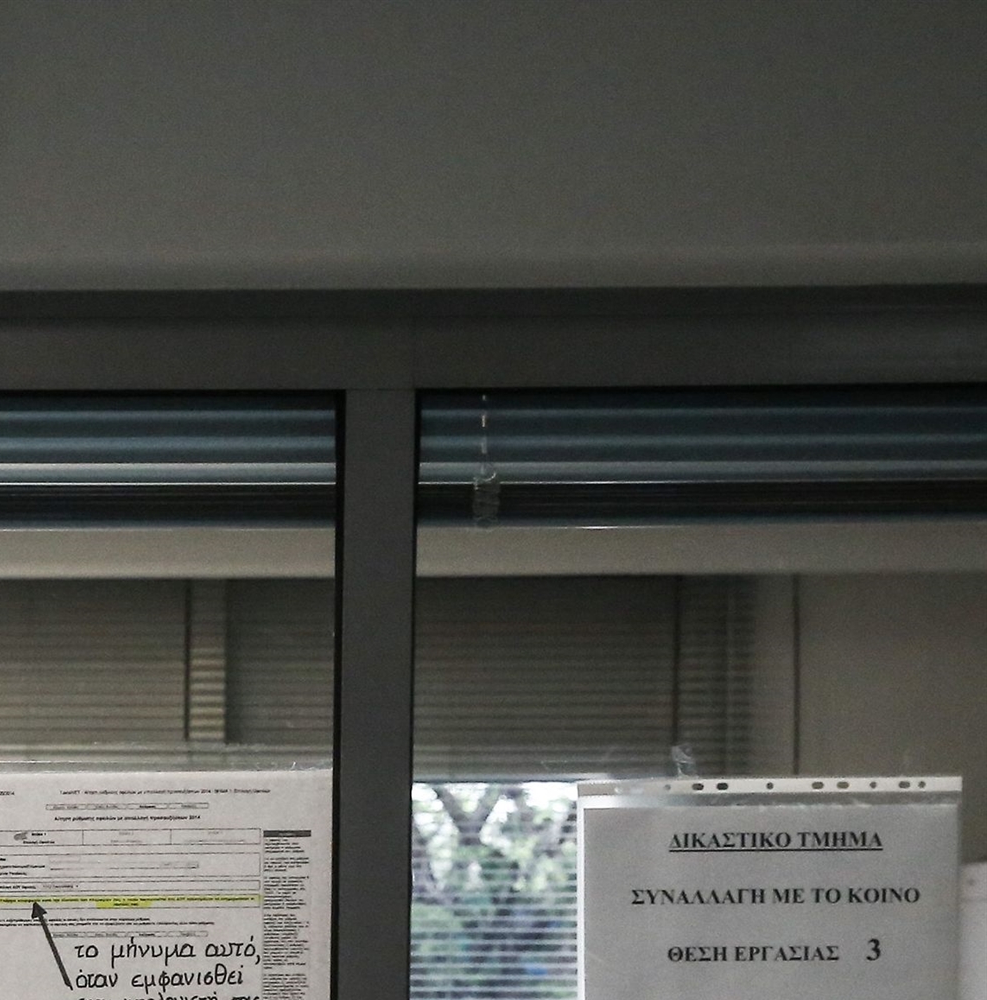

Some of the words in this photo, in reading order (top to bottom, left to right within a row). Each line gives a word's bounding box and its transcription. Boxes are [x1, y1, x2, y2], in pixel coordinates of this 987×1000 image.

[669, 831, 792, 850] ΔΙΚΑΣΤΙΚΟ
[797, 831, 883, 849] ΤΜΗΜΑ
[631, 889, 765, 905] ΣΥΝΑΛΛΑΓΗ
[773, 888, 804, 904] ΜΕ
[811, 888, 841, 904] ΤΟ
[848, 888, 920, 903] ΚΟΙΝΟ
[74, 945, 99, 958] το
[111, 936, 196, 968] μήνυμα
[205, 935, 260, 965] αυτό,
[668, 947, 727, 962] ΘΕΣΗ
[735, 945, 839, 962] ΕΡΓΑΣΙΑΣ
[866, 938, 881, 961] 3
[75, 969, 118, 988] όταν
[131, 963, 244, 994] εμφανισθεί
